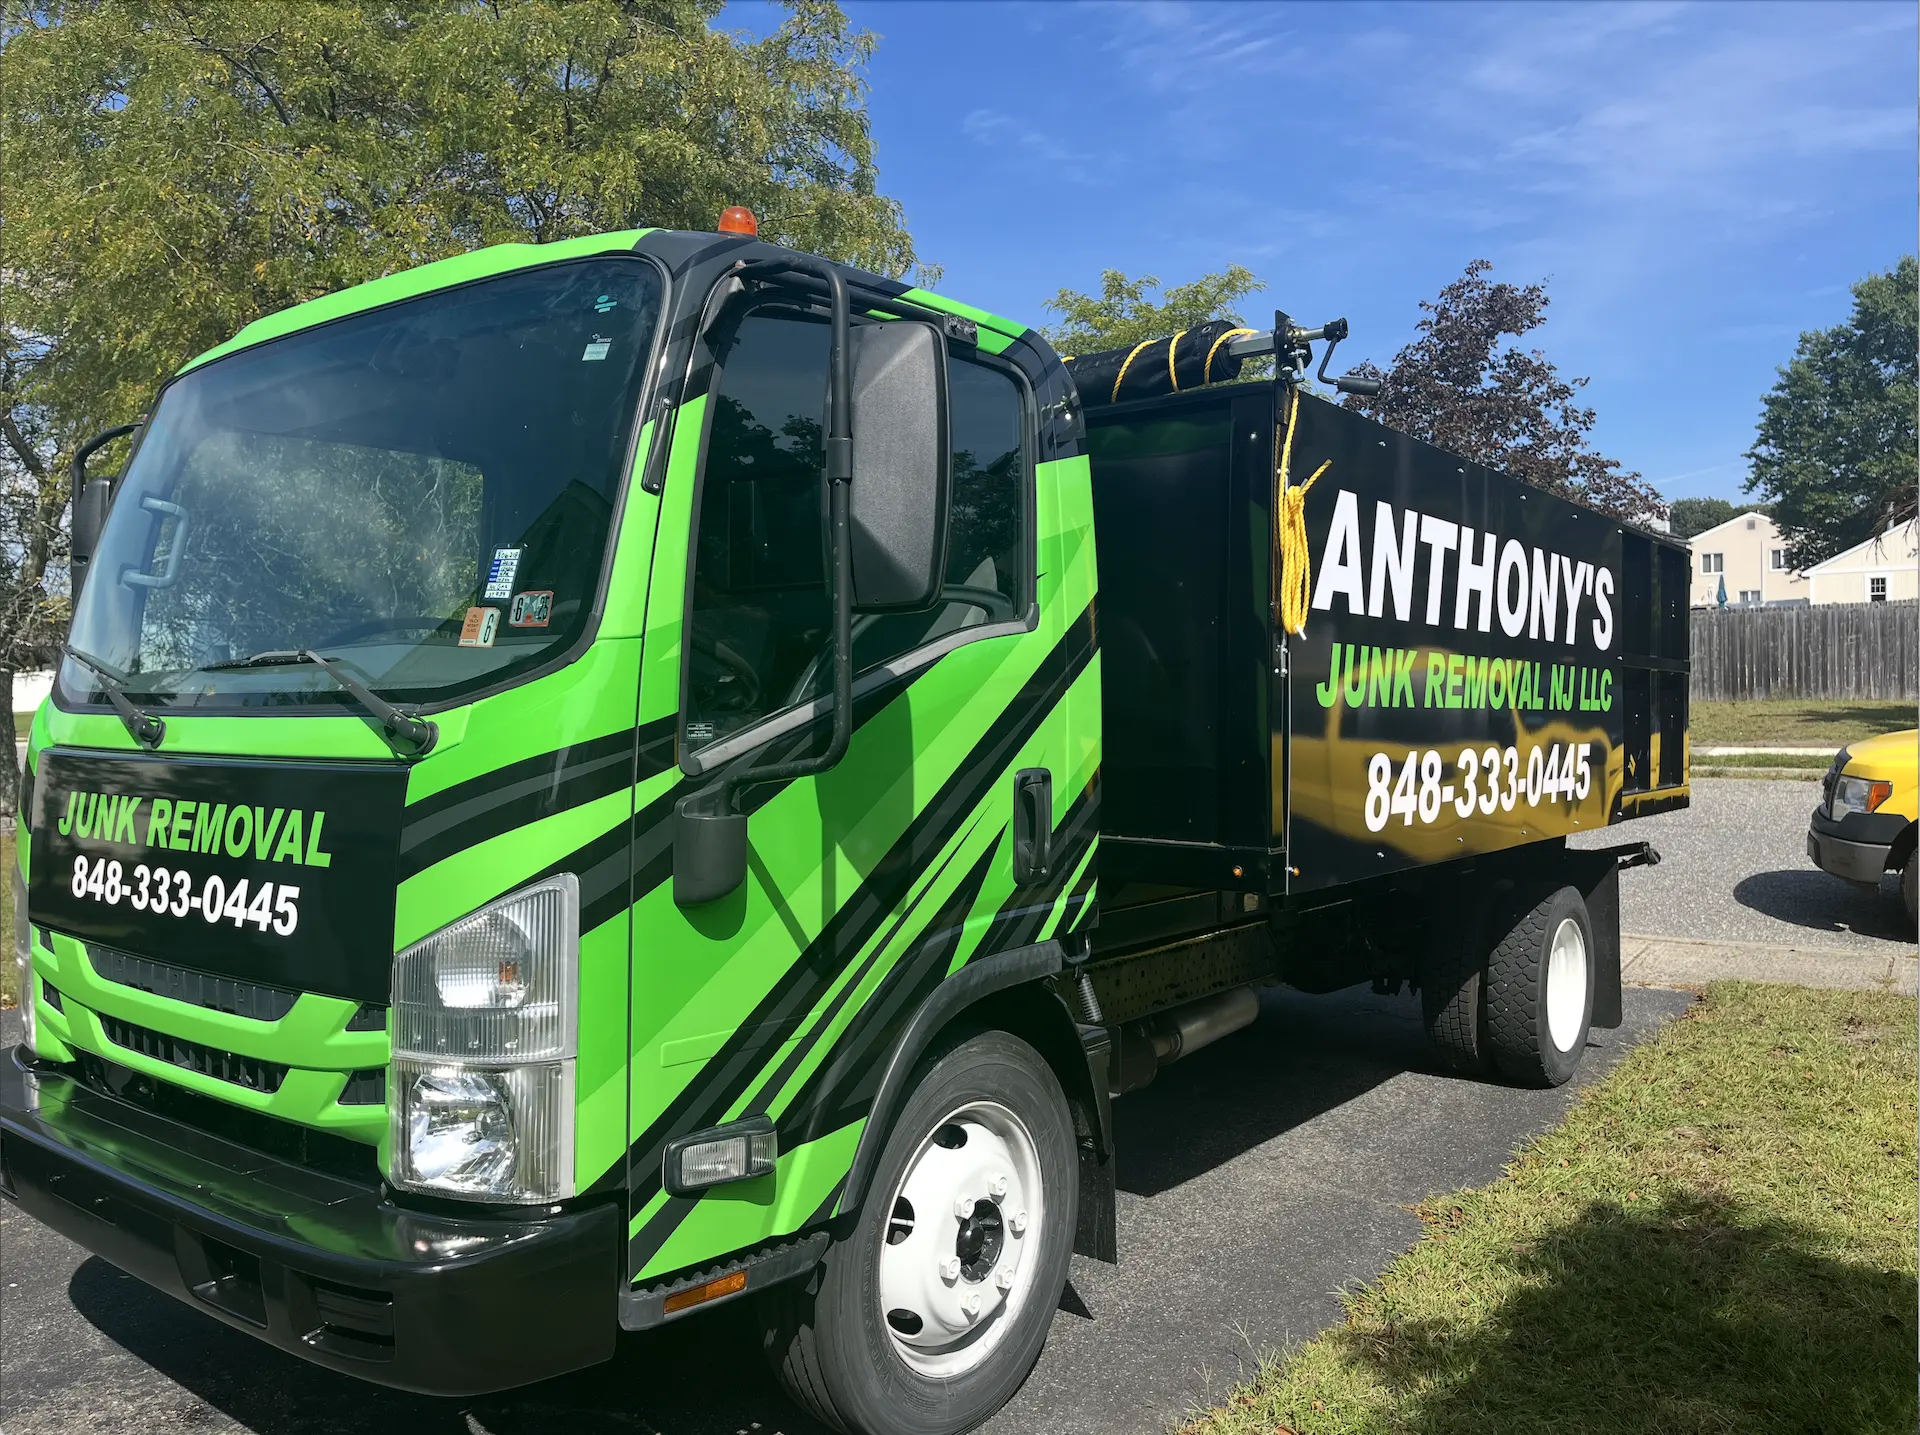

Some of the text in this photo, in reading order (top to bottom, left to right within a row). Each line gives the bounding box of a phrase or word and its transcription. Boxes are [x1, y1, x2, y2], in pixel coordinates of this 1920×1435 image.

[1312, 489, 1614, 651] ANTHONY'S
[483, 613, 494, 644] 6
[515, 597, 524, 622] 6
[537, 596, 550, 620] 25
[1316, 643, 1613, 712] JUNK REMOVAL NJ LLC
[1364, 743, 1590, 832] 848-333-0445
[59, 791, 332, 867] JUNK REMOVAL
[71, 855, 300, 936] 848-333-0445
